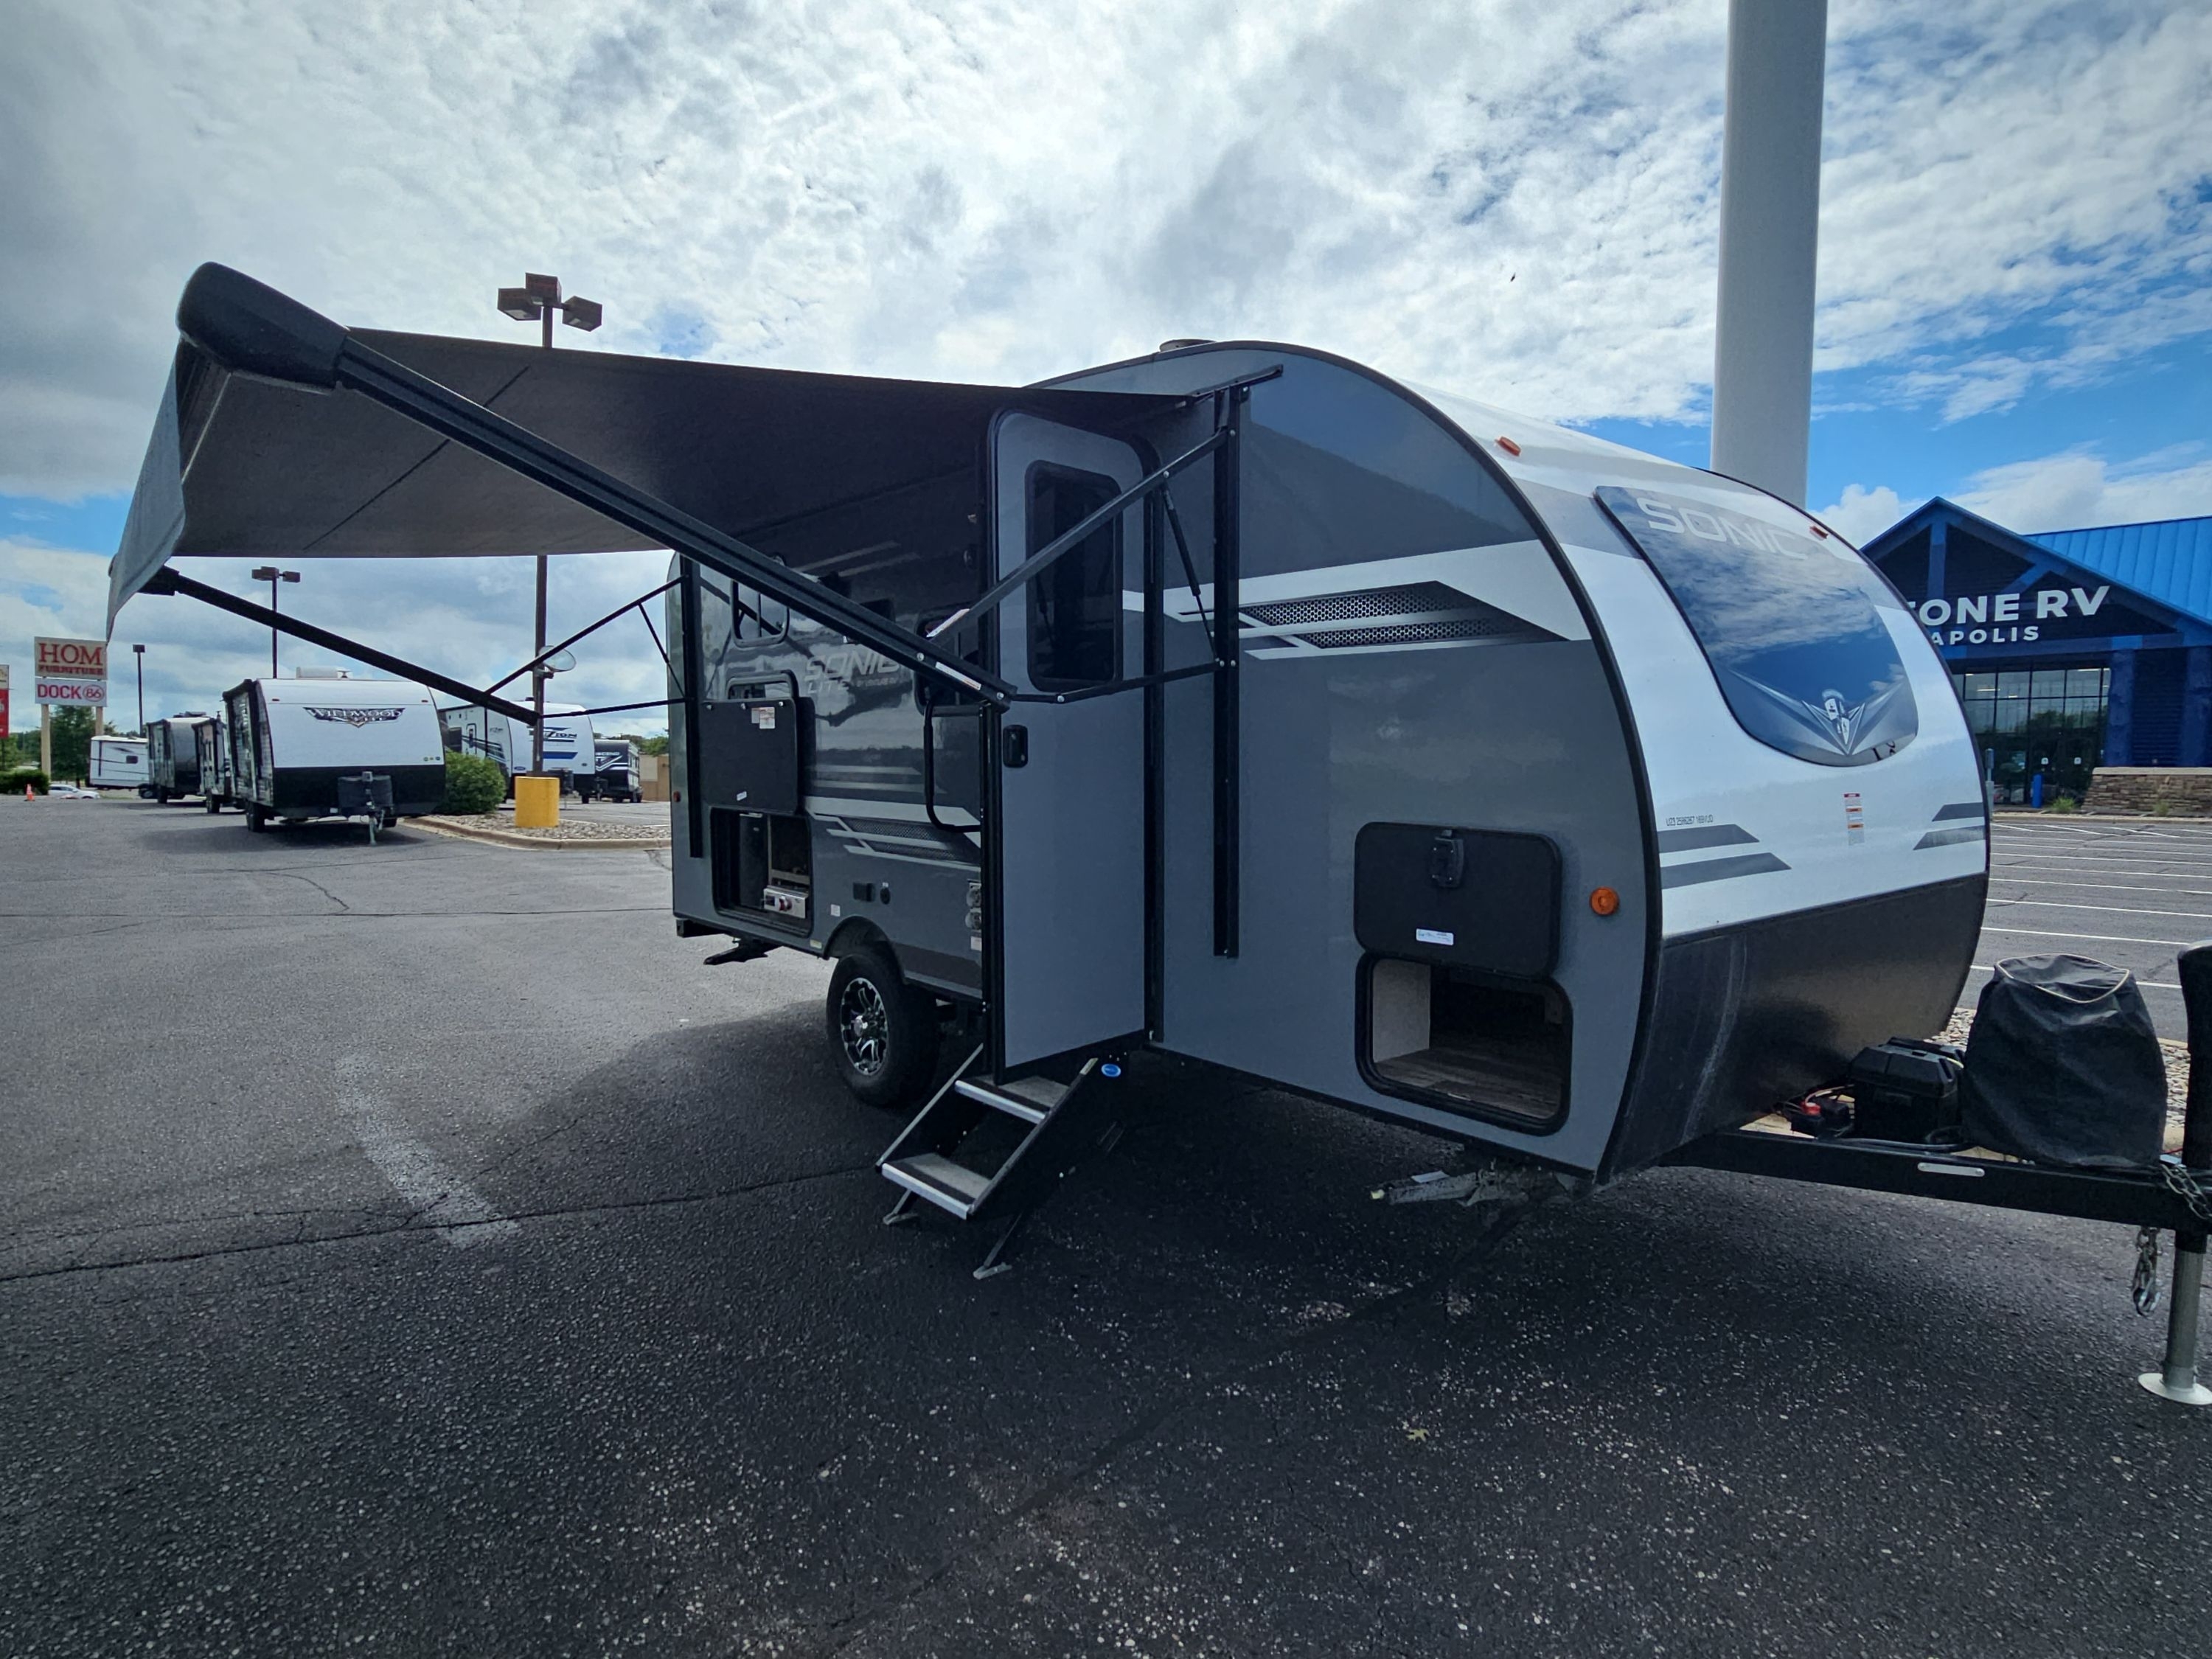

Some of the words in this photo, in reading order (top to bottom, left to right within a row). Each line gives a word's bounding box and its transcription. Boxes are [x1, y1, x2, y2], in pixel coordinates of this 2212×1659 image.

[1636, 497, 1808, 560] SONIC
[2036, 585, 2110, 619] RV
[38, 642, 103, 665] HOM
[804, 650, 900, 681] SONIC
[37, 684, 82, 700] DOCK
